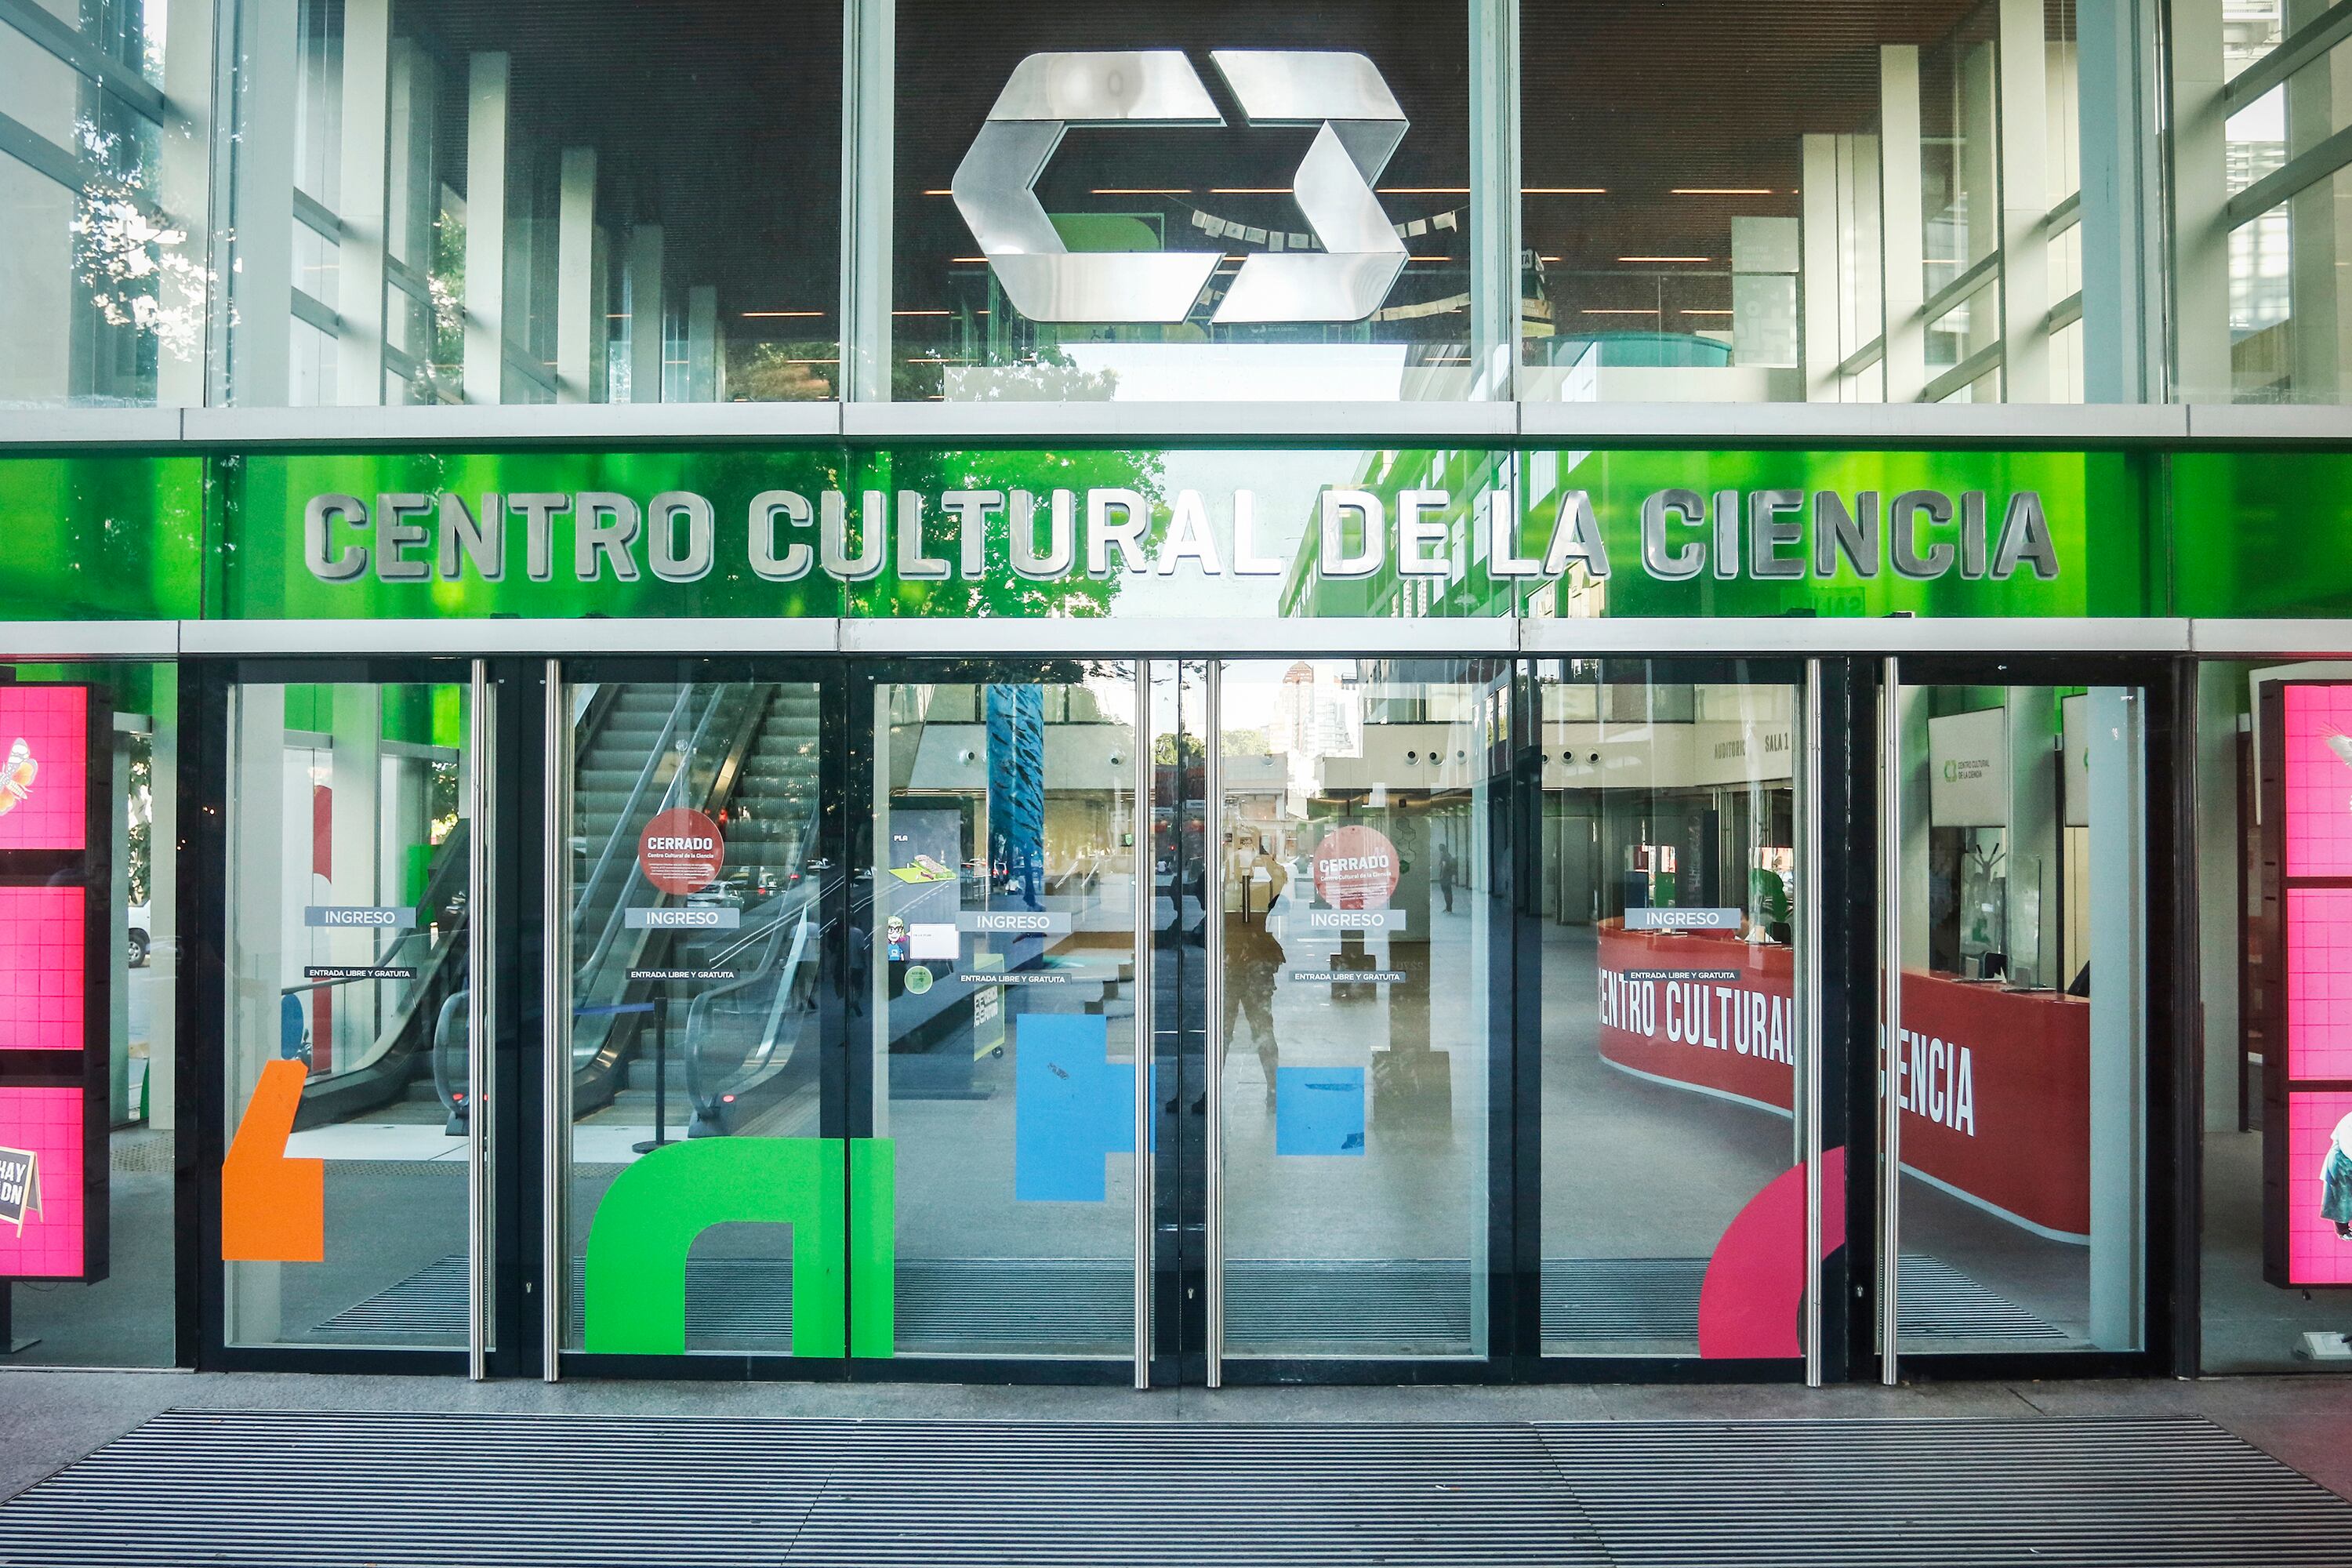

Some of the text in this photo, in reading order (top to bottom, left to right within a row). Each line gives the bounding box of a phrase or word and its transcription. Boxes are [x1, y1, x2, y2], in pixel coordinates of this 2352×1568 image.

[304, 488, 2060, 581] CENTRO CULTURAL DE LA CIENCIA
[1765, 733, 1783, 753] SALA
[1784, 732, 1789, 750] 1
[648, 837, 713, 851] CERRADO
[1319, 855, 1389, 873] CERRADO
[325, 911, 395, 924] INGRESO
[646, 912, 718, 924] INGRESO
[977, 915, 1050, 929] INGRESO
[1311, 913, 1385, 927] INGRESO
[1646, 912, 1719, 925] INGRESO
[1666, 981, 1794, 1066] CULTURAL
[1881, 1022, 1974, 1137] ENCIA
[0, 1181, 23, 1205] DN
